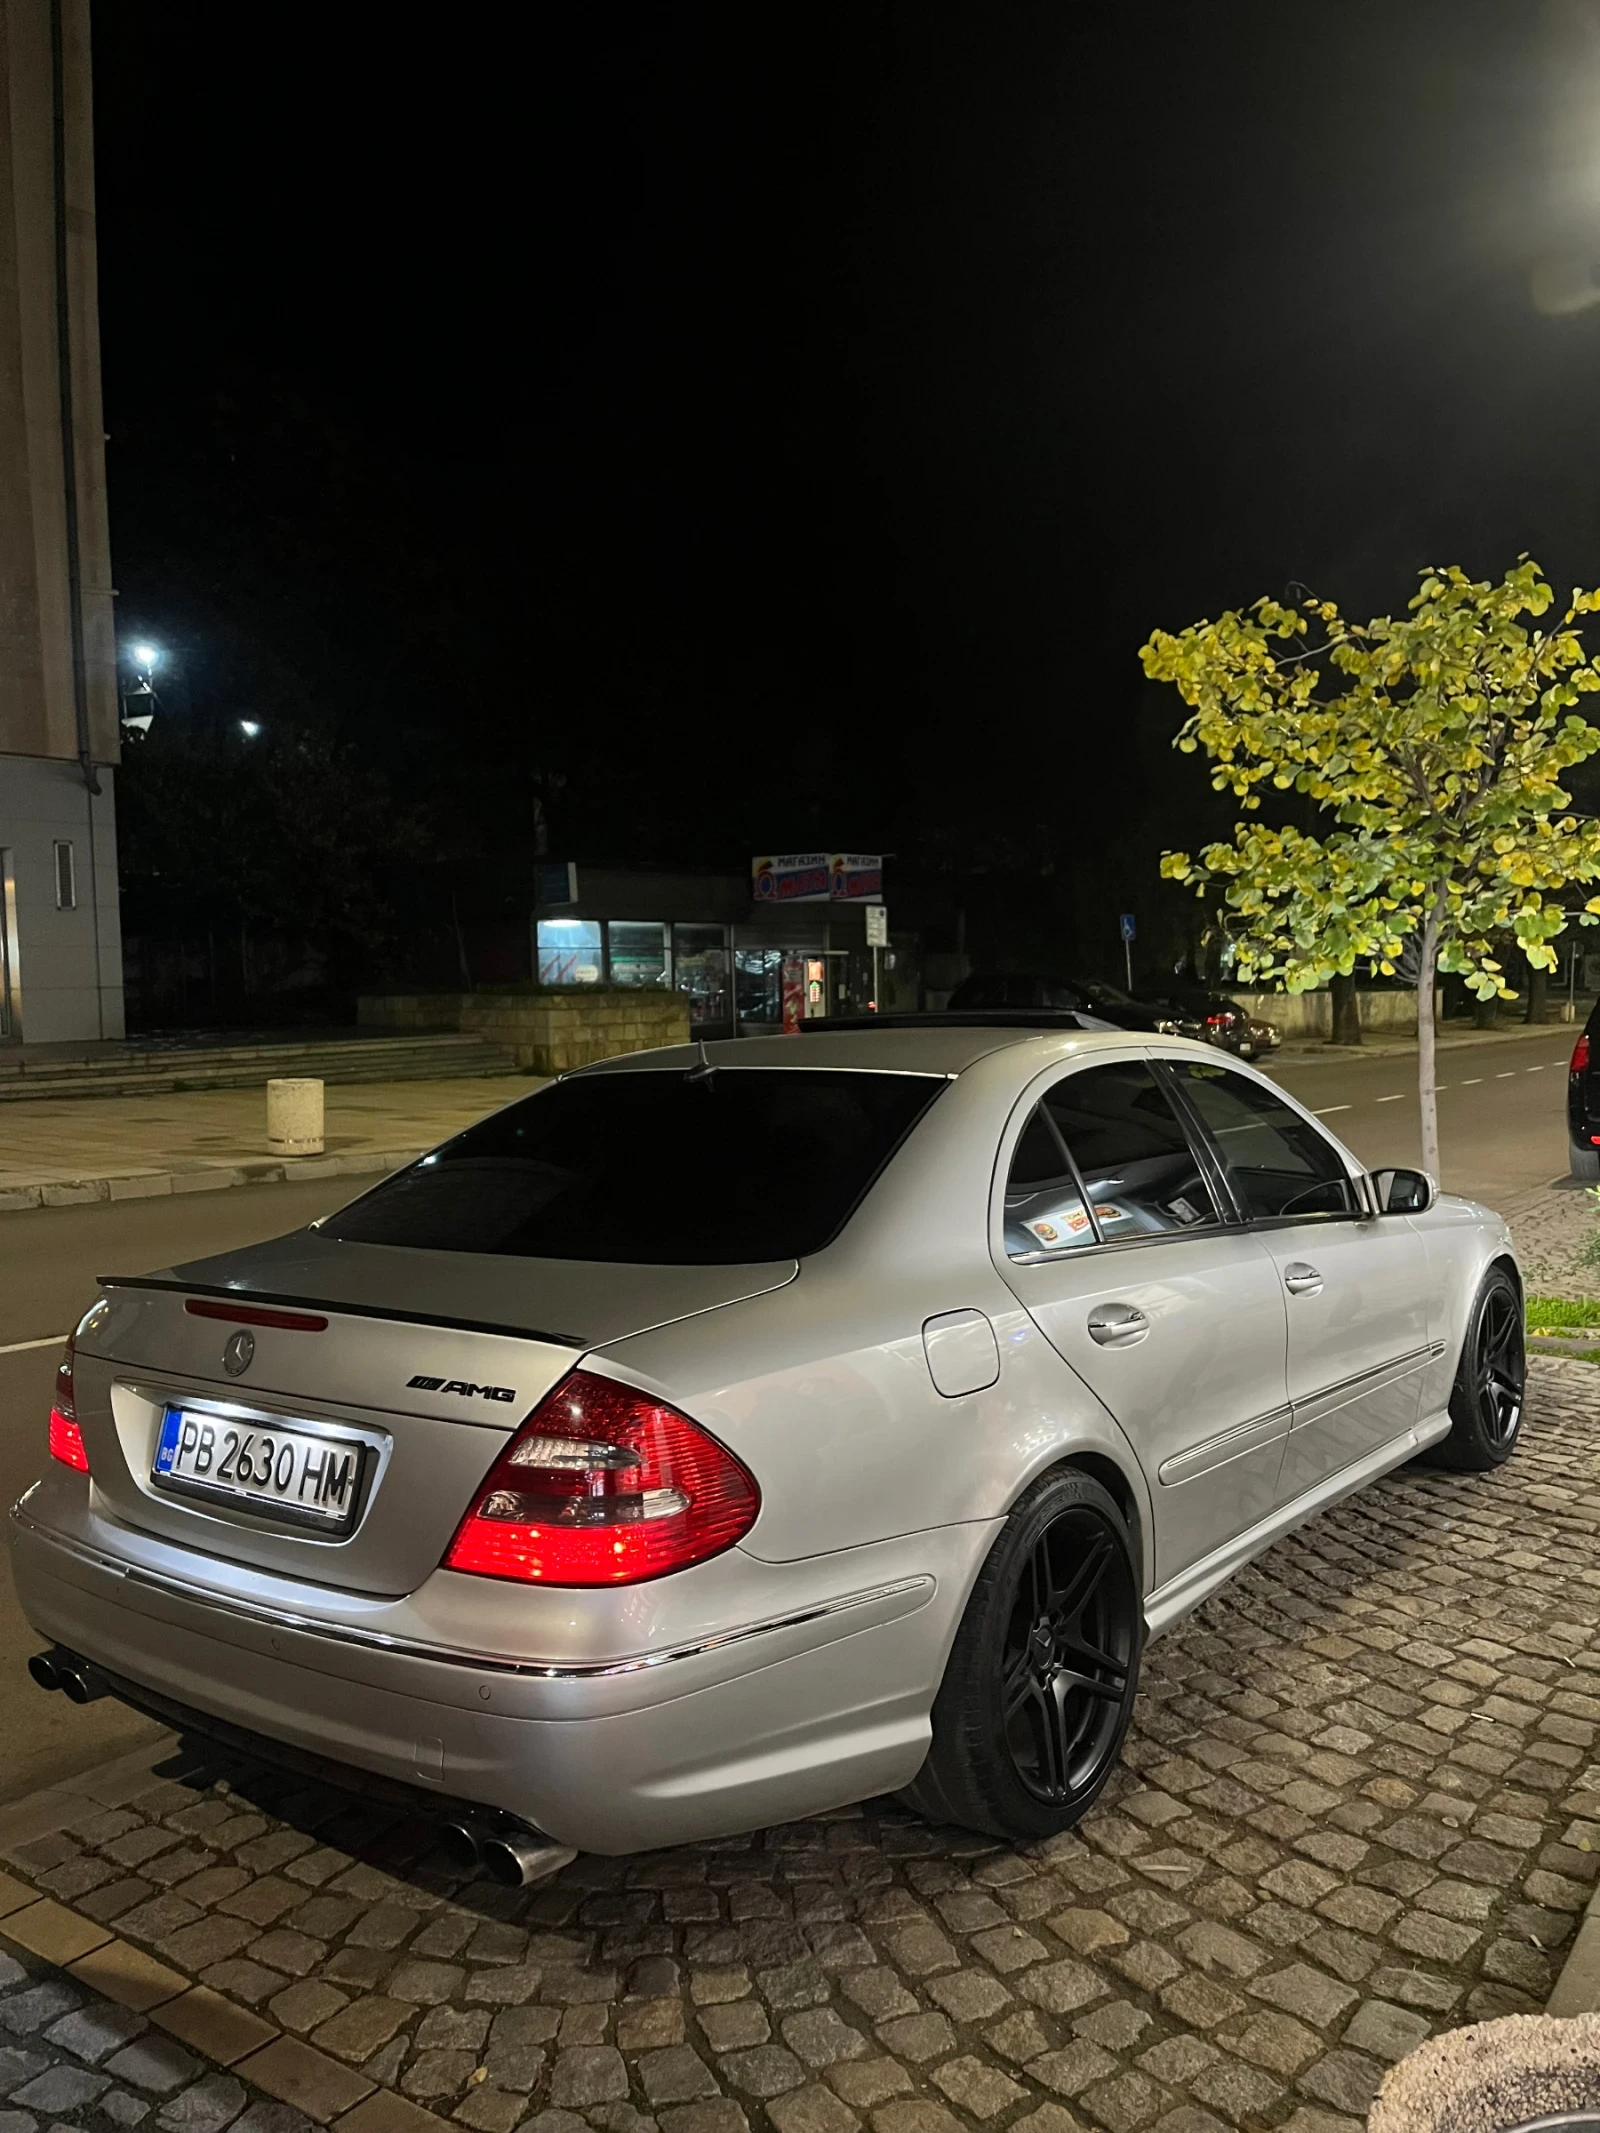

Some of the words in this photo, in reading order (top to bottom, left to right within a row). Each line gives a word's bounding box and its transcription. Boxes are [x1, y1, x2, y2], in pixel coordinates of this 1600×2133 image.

[778, 855, 826, 867] МАГАЗИН
[846, 855, 879, 866] МАГАЗИН
[440, 1380, 516, 1403] AMG
[160, 1446, 174, 1463] BG
[177, 1421, 215, 1475] PB
[216, 1431, 296, 1492] 2630
[298, 1448, 352, 1506] HM
